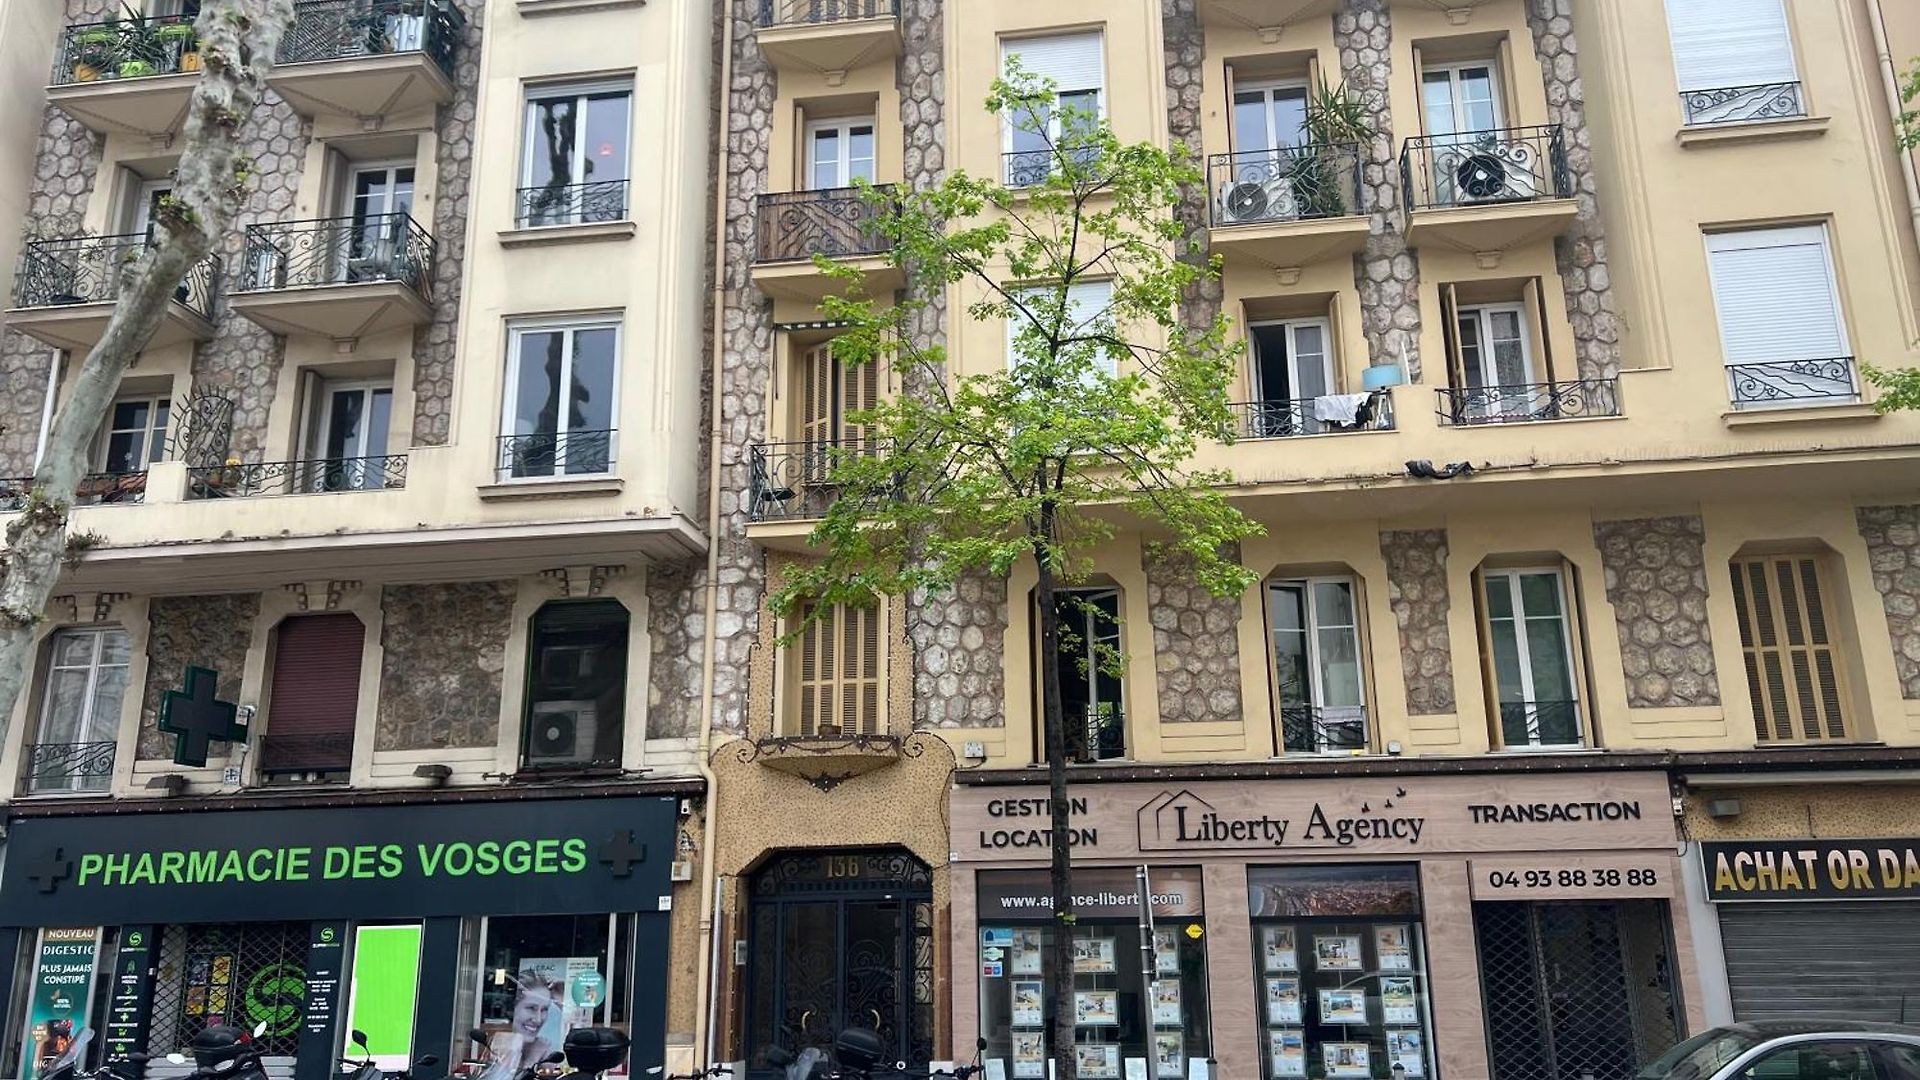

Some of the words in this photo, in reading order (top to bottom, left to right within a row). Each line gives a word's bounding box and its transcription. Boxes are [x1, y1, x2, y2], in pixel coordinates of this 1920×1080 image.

[987, 798, 1087, 817] GESTIN
[1468, 801, 1641, 823] TRANSACTION
[1174, 806, 1289, 845] Liberty
[1303, 803, 1424, 844] Agency
[980, 828, 1097, 848] LOCATON
[78, 847, 311, 885] PHARMACIE
[323, 844, 403, 879] DES
[418, 838, 586, 876] VOSGES
[1715, 850, 1819, 891] ACHAT
[1827, 850, 1874, 890] OR
[1489, 870, 1520, 888] 04
[1524, 870, 1552, 887] 93
[1558, 870, 1587, 887] 88
[1592, 869, 1621, 886] 38
[1627, 869, 1657, 886] 88
[1000, 892, 1184, 910] www.ance-libertcom
[48, 929, 94, 938] NOUVEAU
[40, 964, 61, 973] PLUS
[62, 964, 92, 973] JAMAIS
[44, 974, 85, 984] CONSTIPÉ
